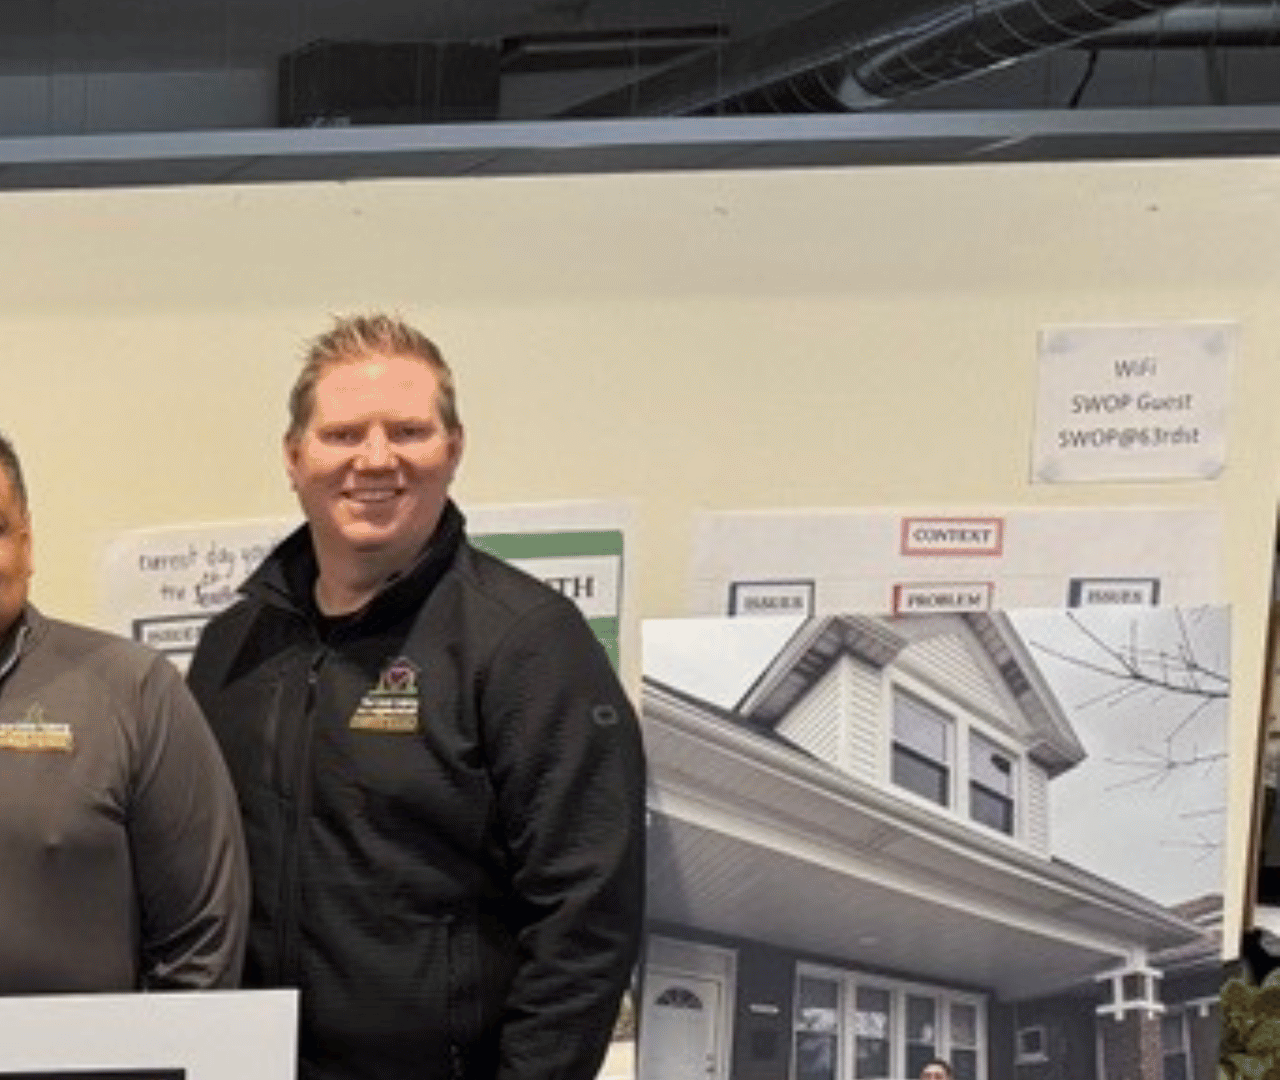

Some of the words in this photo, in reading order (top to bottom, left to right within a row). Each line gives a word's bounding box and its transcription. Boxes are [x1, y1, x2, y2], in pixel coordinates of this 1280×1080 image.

[1071, 393, 1132, 414] SWOP
[1136, 392, 1193, 412] Guest
[544, 576, 594, 598] TH
